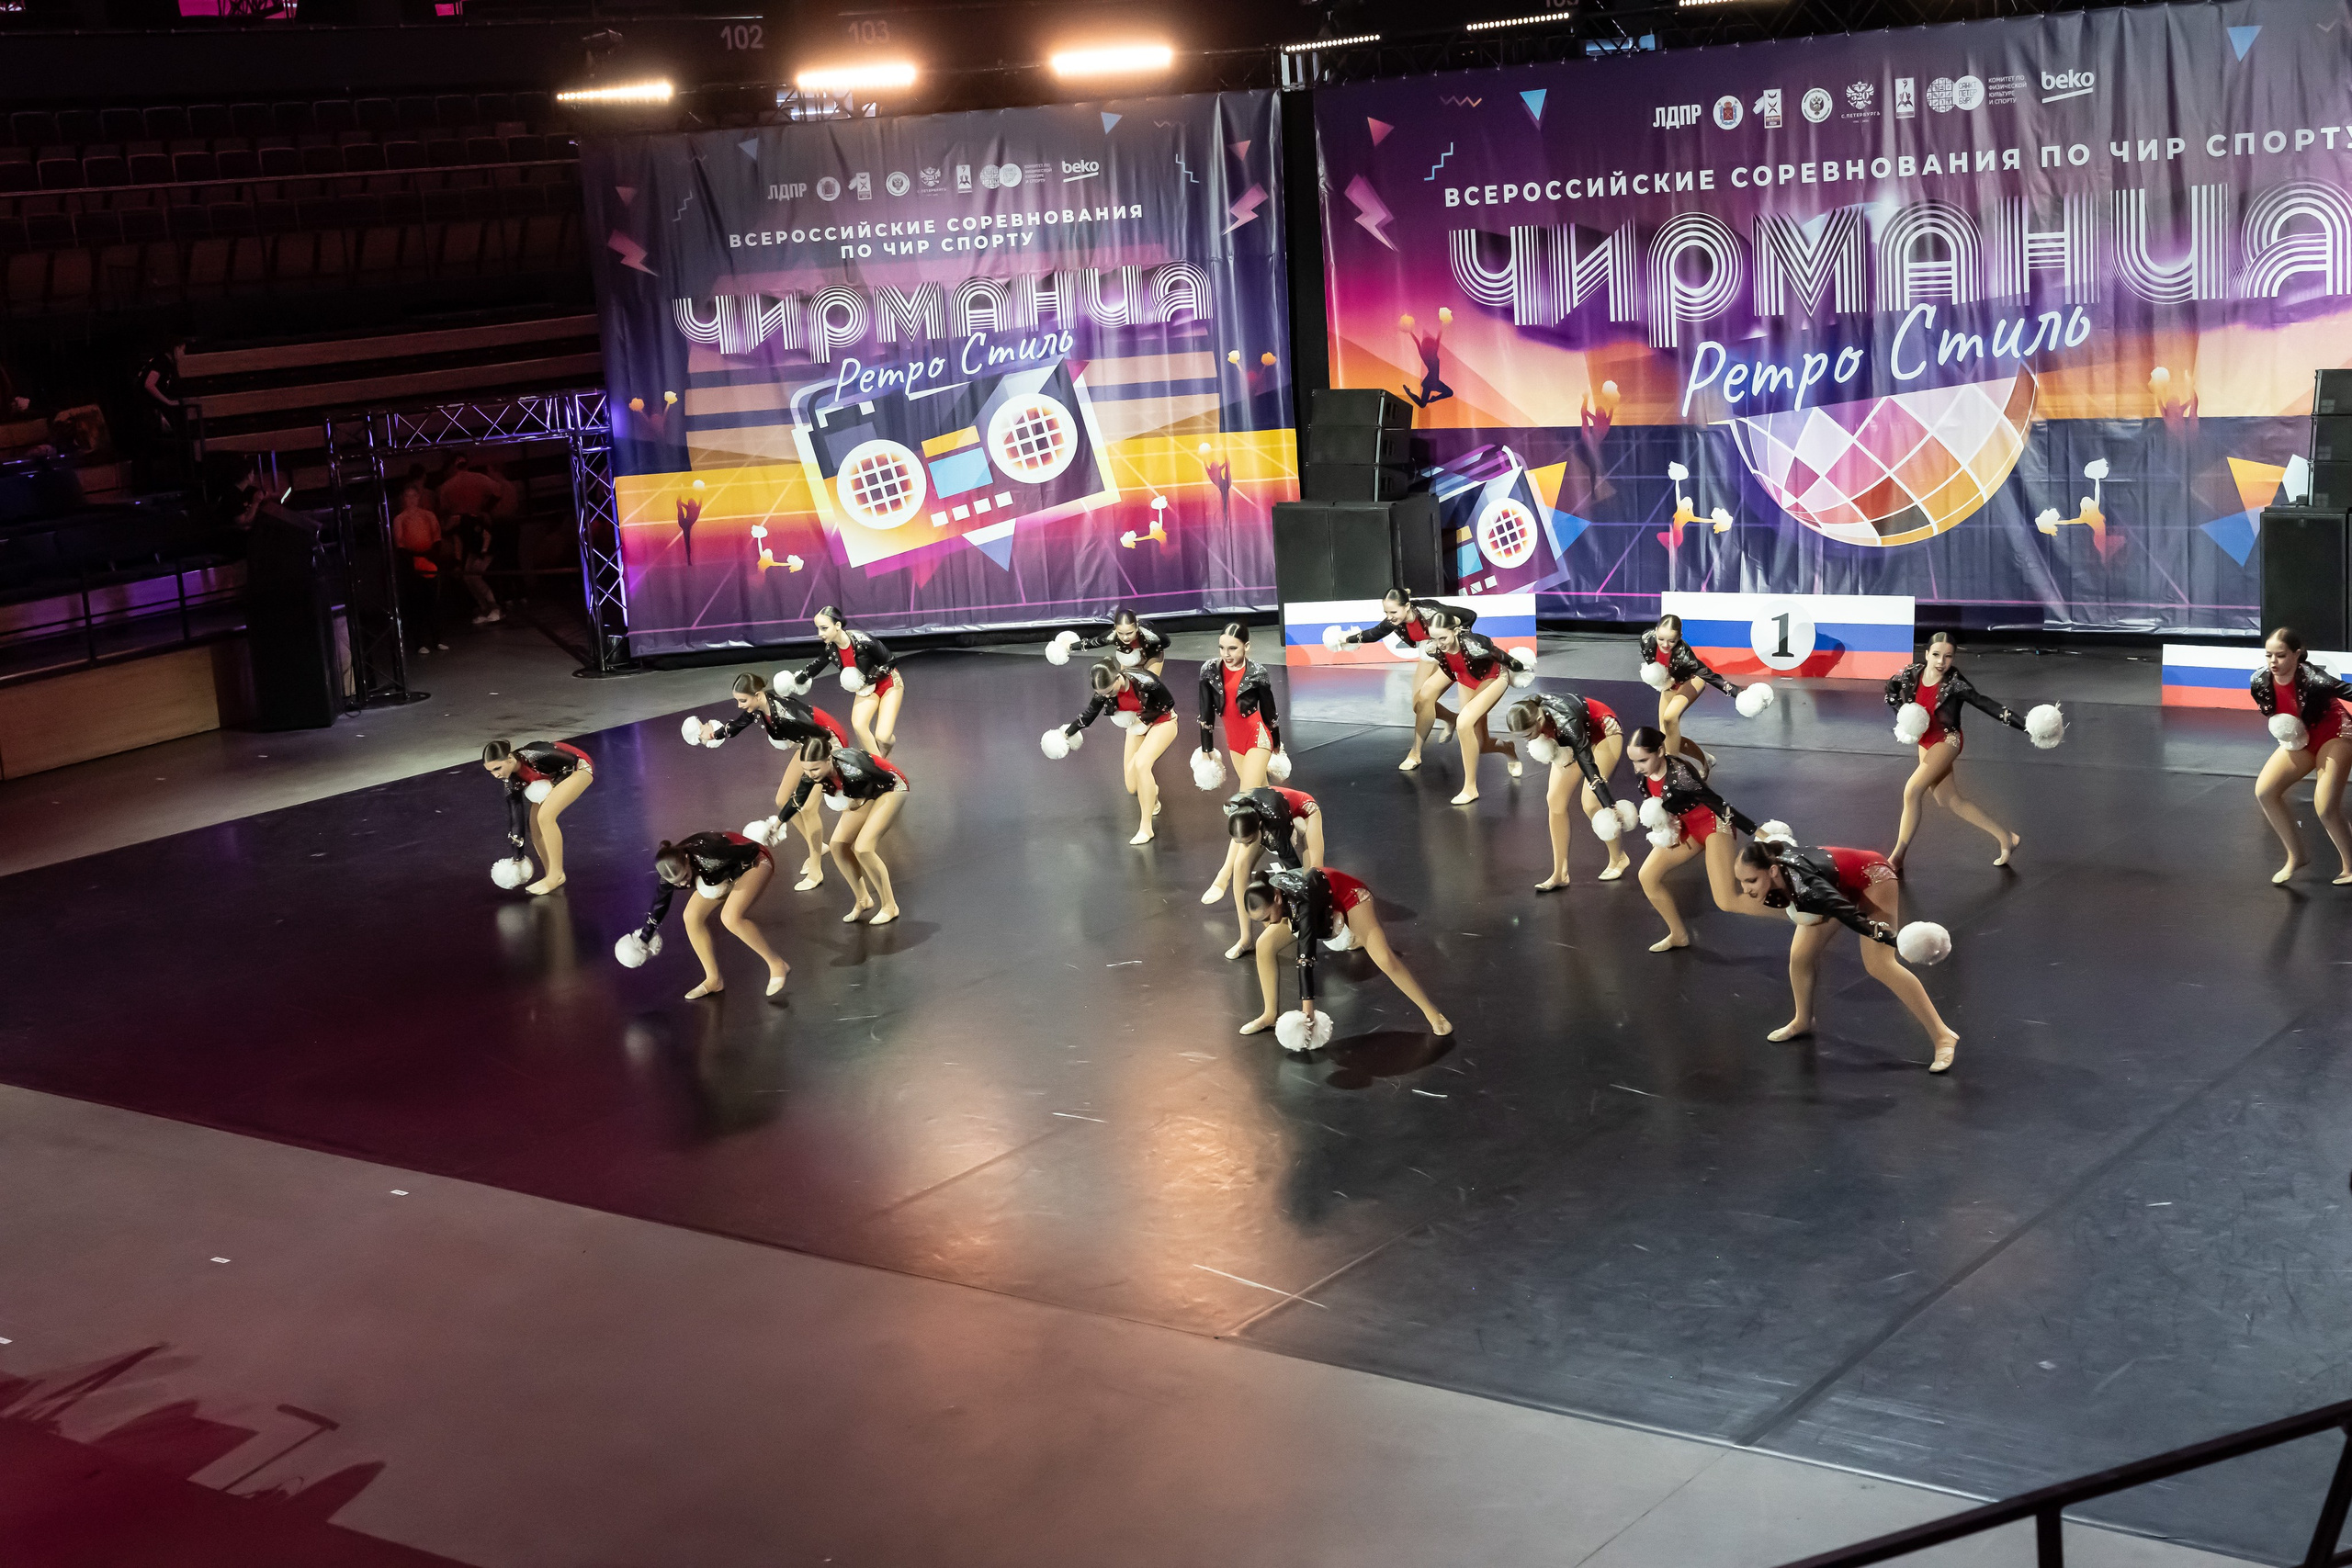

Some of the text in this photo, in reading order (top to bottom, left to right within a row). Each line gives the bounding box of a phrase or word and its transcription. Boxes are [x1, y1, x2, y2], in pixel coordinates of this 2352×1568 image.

[720, 25, 763, 51] 102
[848, 19, 890, 45] 103
[1988, 81, 2027, 90] ФИЗИЧЕСКОЙ
[2041, 69, 2095, 90] beko
[1653, 104, 1702, 130] ЛДПР
[1061, 159, 1100, 174] beko
[1445, 169, 1714, 208] ВСЕРОССИЙСКИЕ
[1731, 148, 2020, 187] СОРЕВНОВАНИЯ
[2041, 143, 2090, 168] ПО
[2109, 137, 2186, 163] ЧИР
[767, 183, 808, 201] ЛДПР
[729, 204, 1144, 248] ВСЕРОССИЙСКИЕ СОРЕВНОВАНИЯ
[841, 231, 1035, 259] ПО ЧИР СПОРТУ
[834, 330, 1074, 402] Ретро Стиль
[1681, 303, 2091, 417] Ретро Стиль
[1771, 613, 1795, 658] 1
